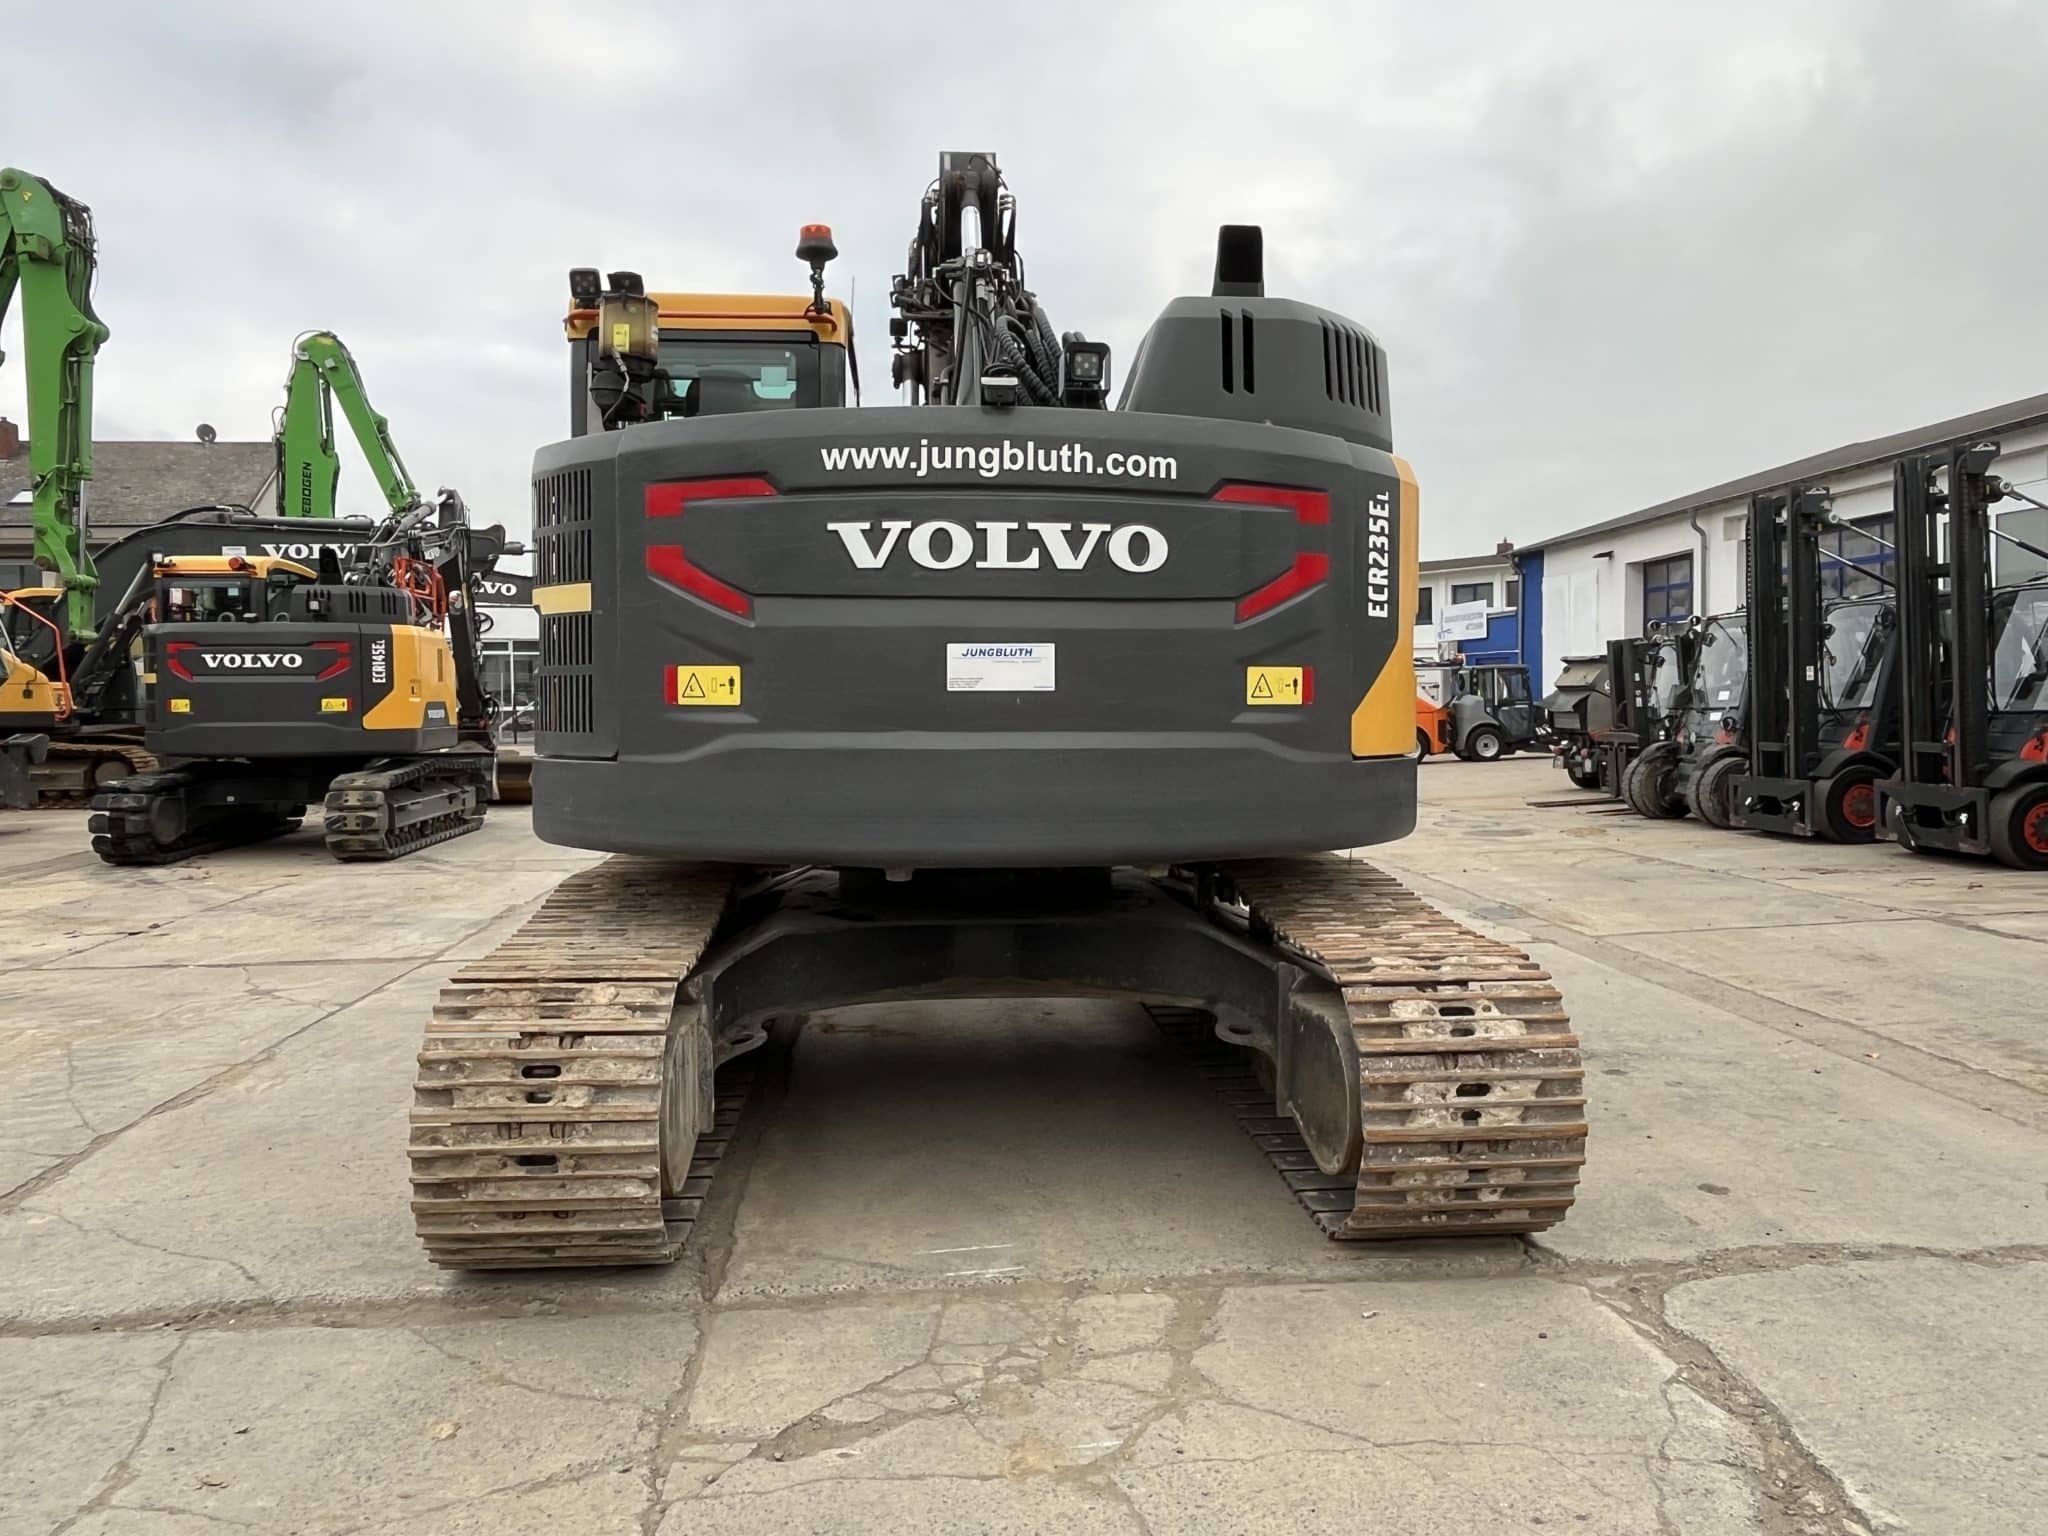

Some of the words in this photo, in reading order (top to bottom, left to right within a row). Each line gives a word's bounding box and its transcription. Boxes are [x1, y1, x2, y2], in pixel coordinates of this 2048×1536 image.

[820, 439, 1178, 481] www.jungbluth.com
[825, 520, 1170, 574] VOLVO
[1367, 490, 1390, 619] ECR235EL
[201, 653, 303, 668] VOLVO
[961, 647, 1034, 658] JUNGBLUTH
